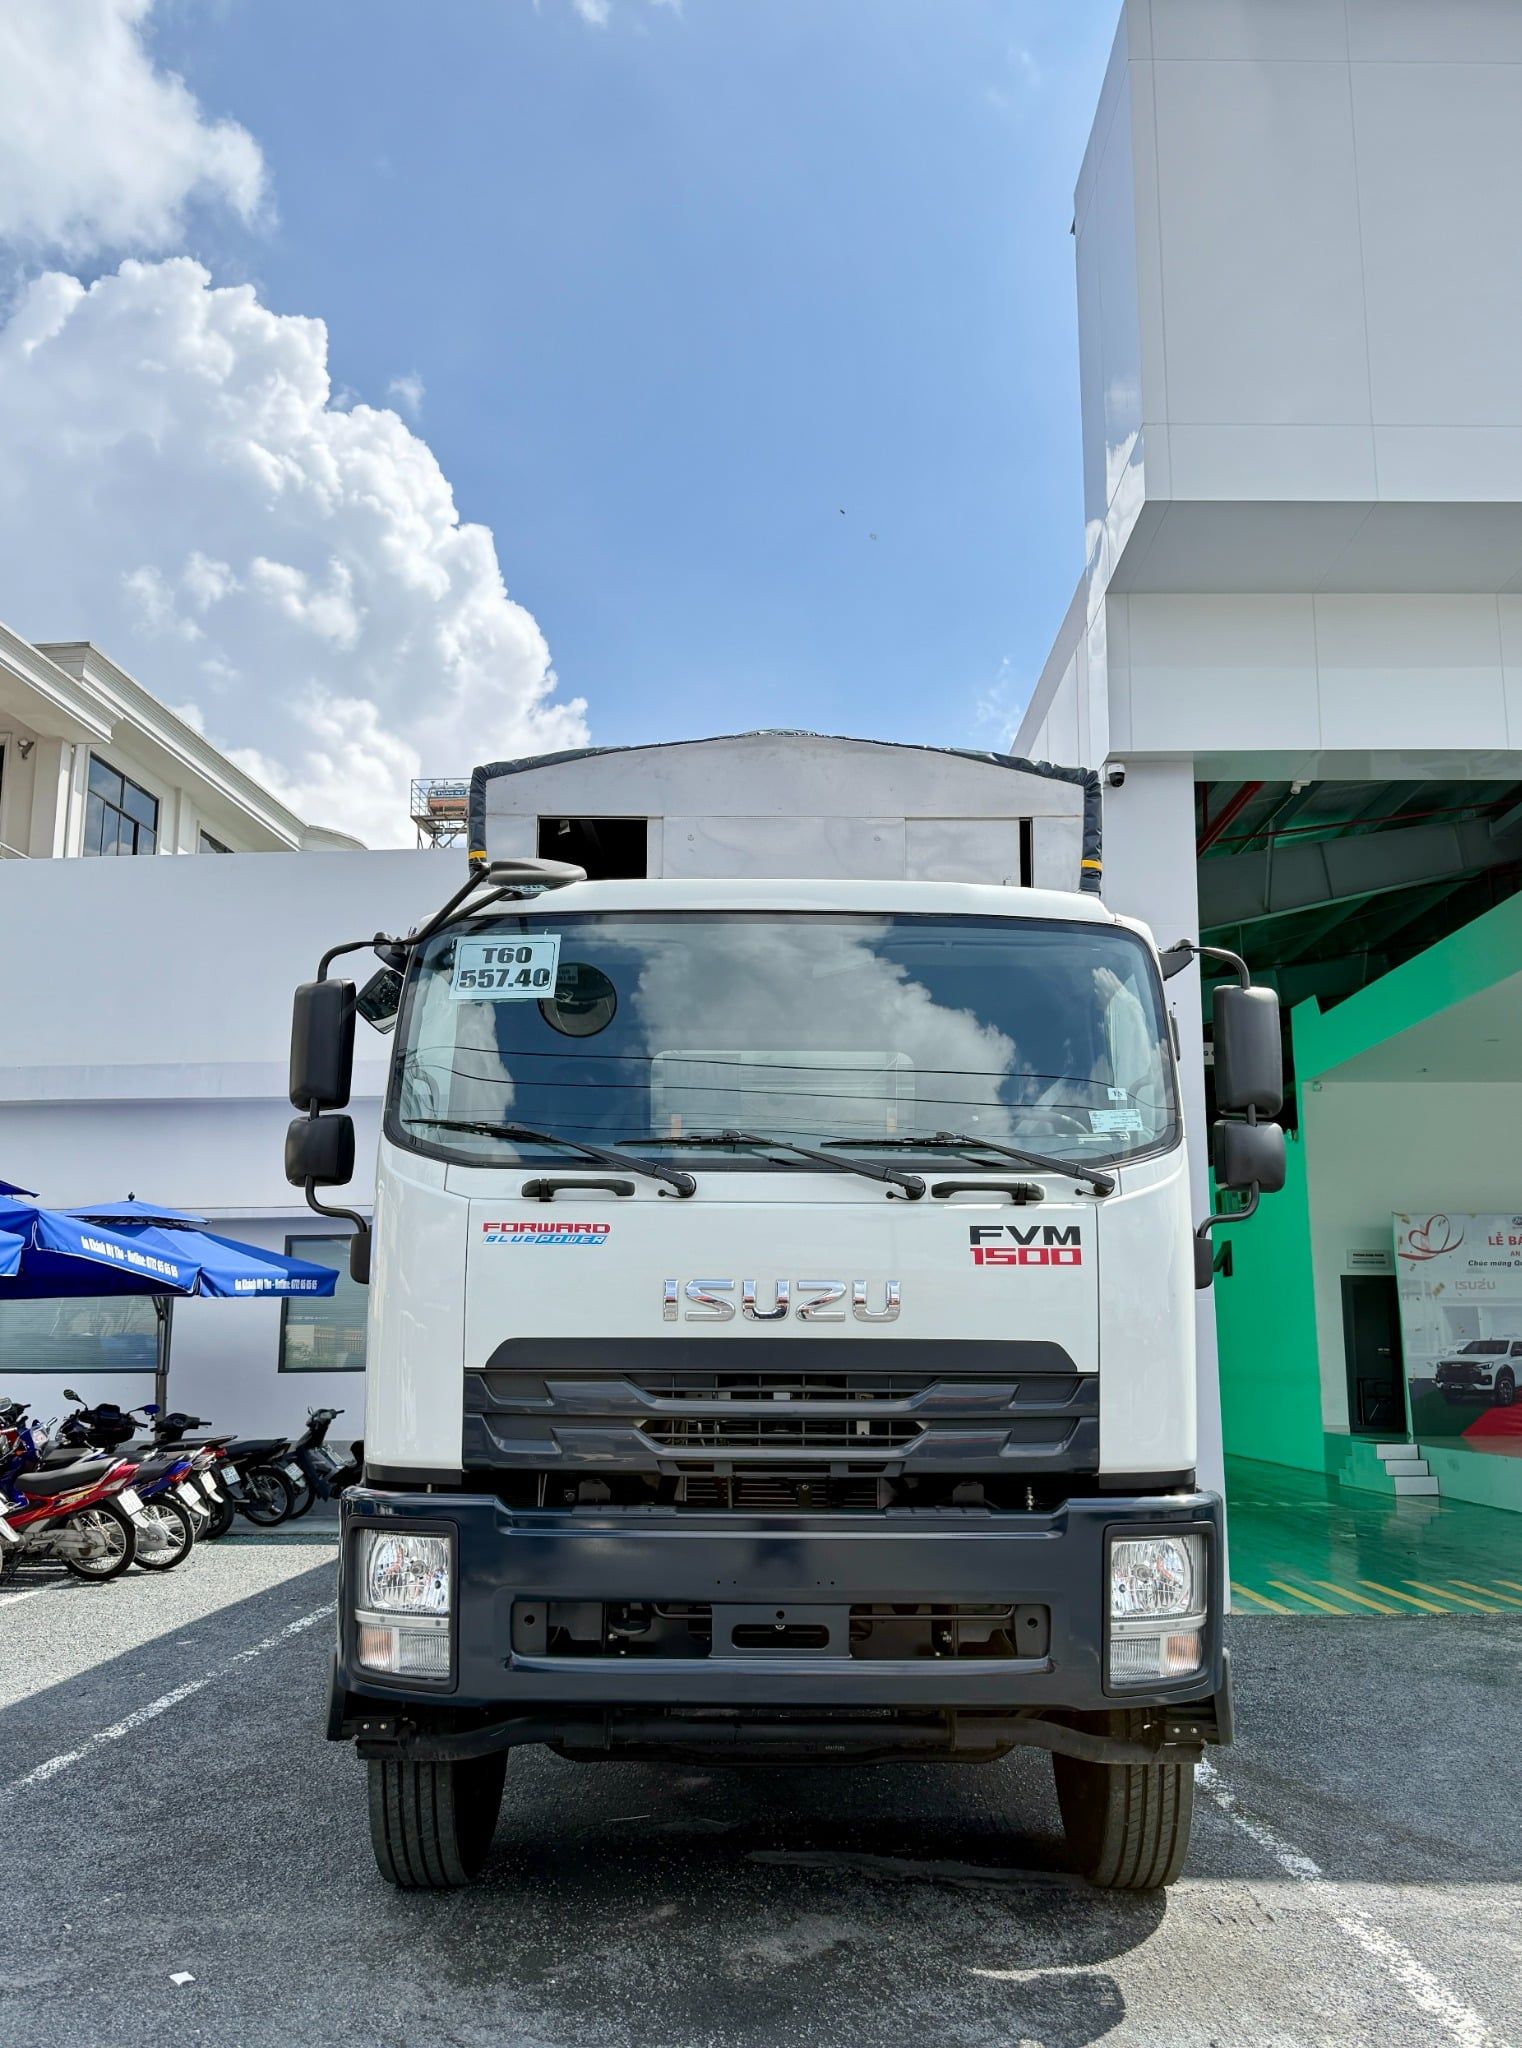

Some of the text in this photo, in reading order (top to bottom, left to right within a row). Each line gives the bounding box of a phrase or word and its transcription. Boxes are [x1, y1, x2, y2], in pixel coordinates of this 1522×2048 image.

[482, 946, 533, 964] T60
[459, 968, 550, 989] 557.40
[482, 1222, 611, 1234] FORWARD
[969, 1225, 1081, 1246] FVM
[969, 1247, 1082, 1265] 1500
[1455, 1280, 1496, 1290] ISUZU
[663, 1278, 902, 1323] ISUZU
